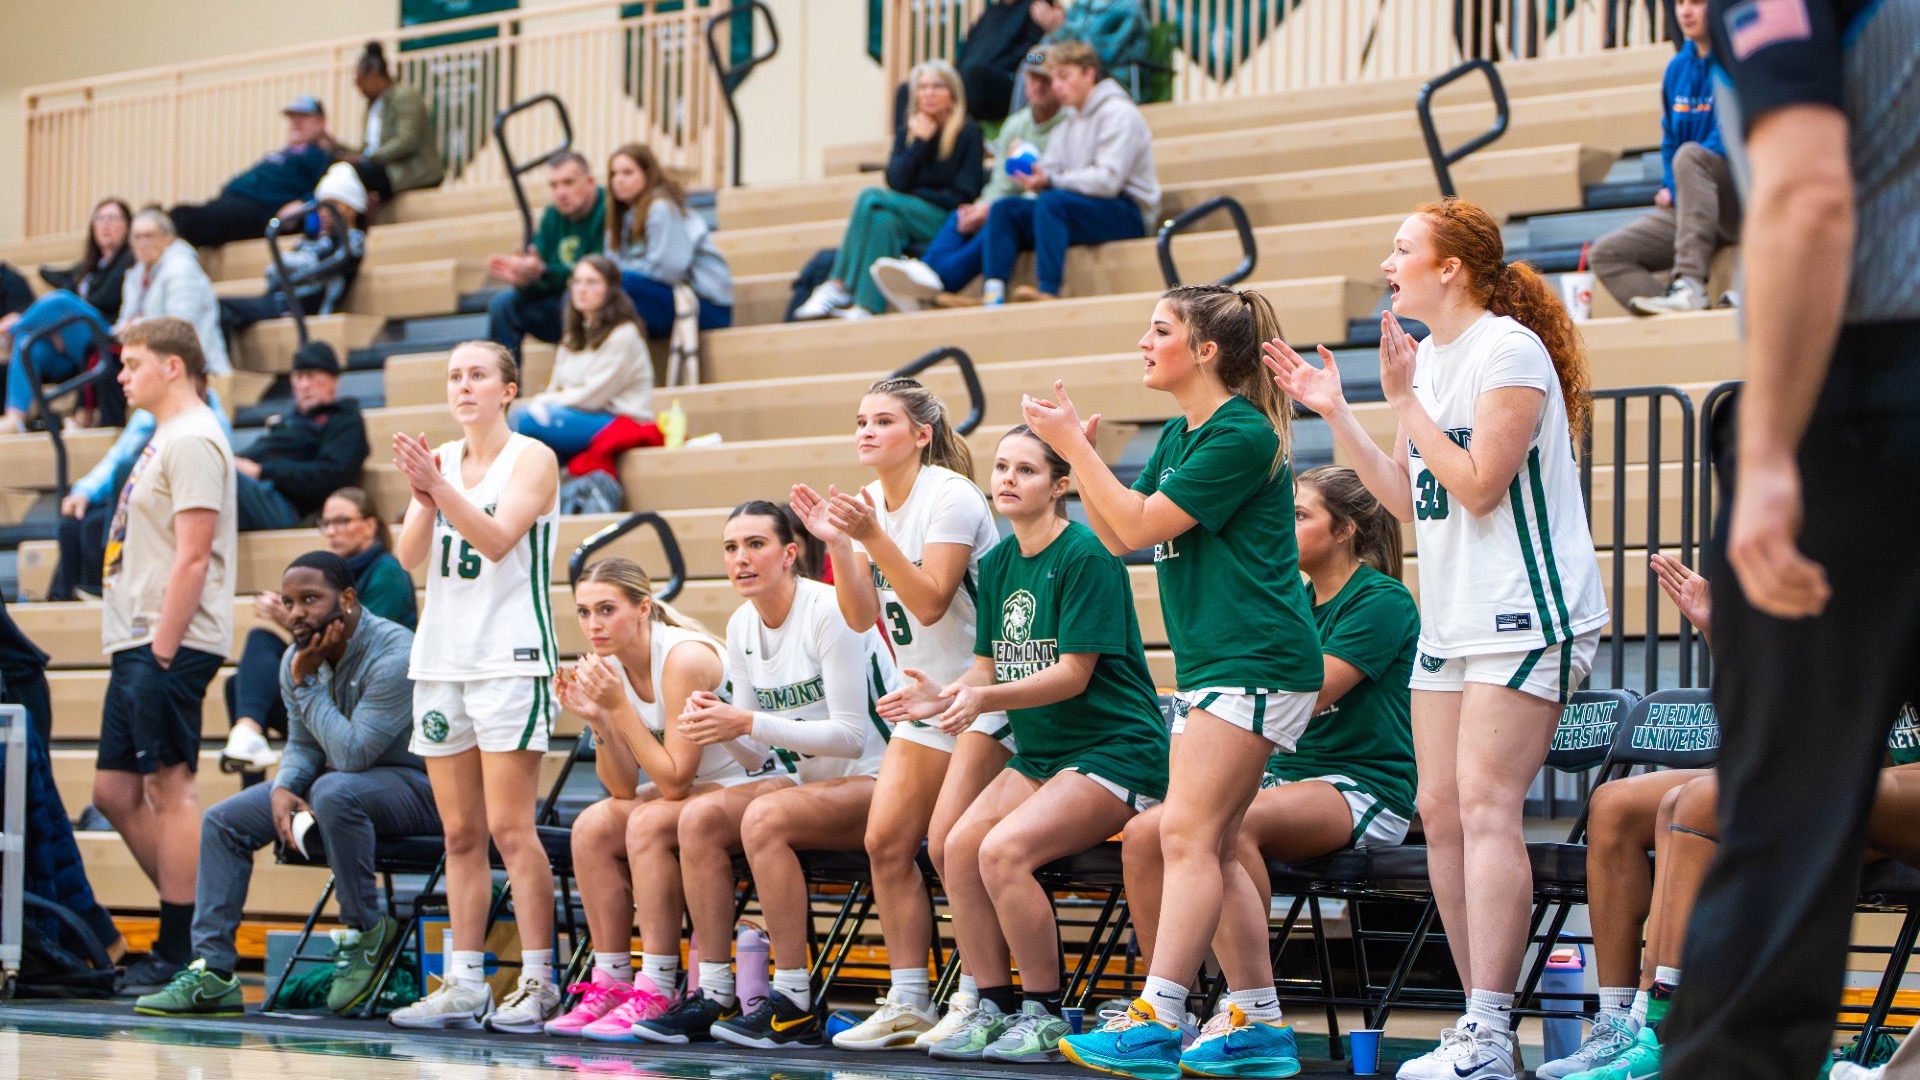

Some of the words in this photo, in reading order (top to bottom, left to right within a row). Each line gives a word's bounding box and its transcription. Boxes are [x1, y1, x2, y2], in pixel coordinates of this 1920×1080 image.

[1416, 468, 1449, 520] 33
[441, 534, 482, 579] 15
[885, 601, 913, 646] 3
[992, 638, 1058, 663] EDMONT
[752, 674, 826, 711] EDMONT
